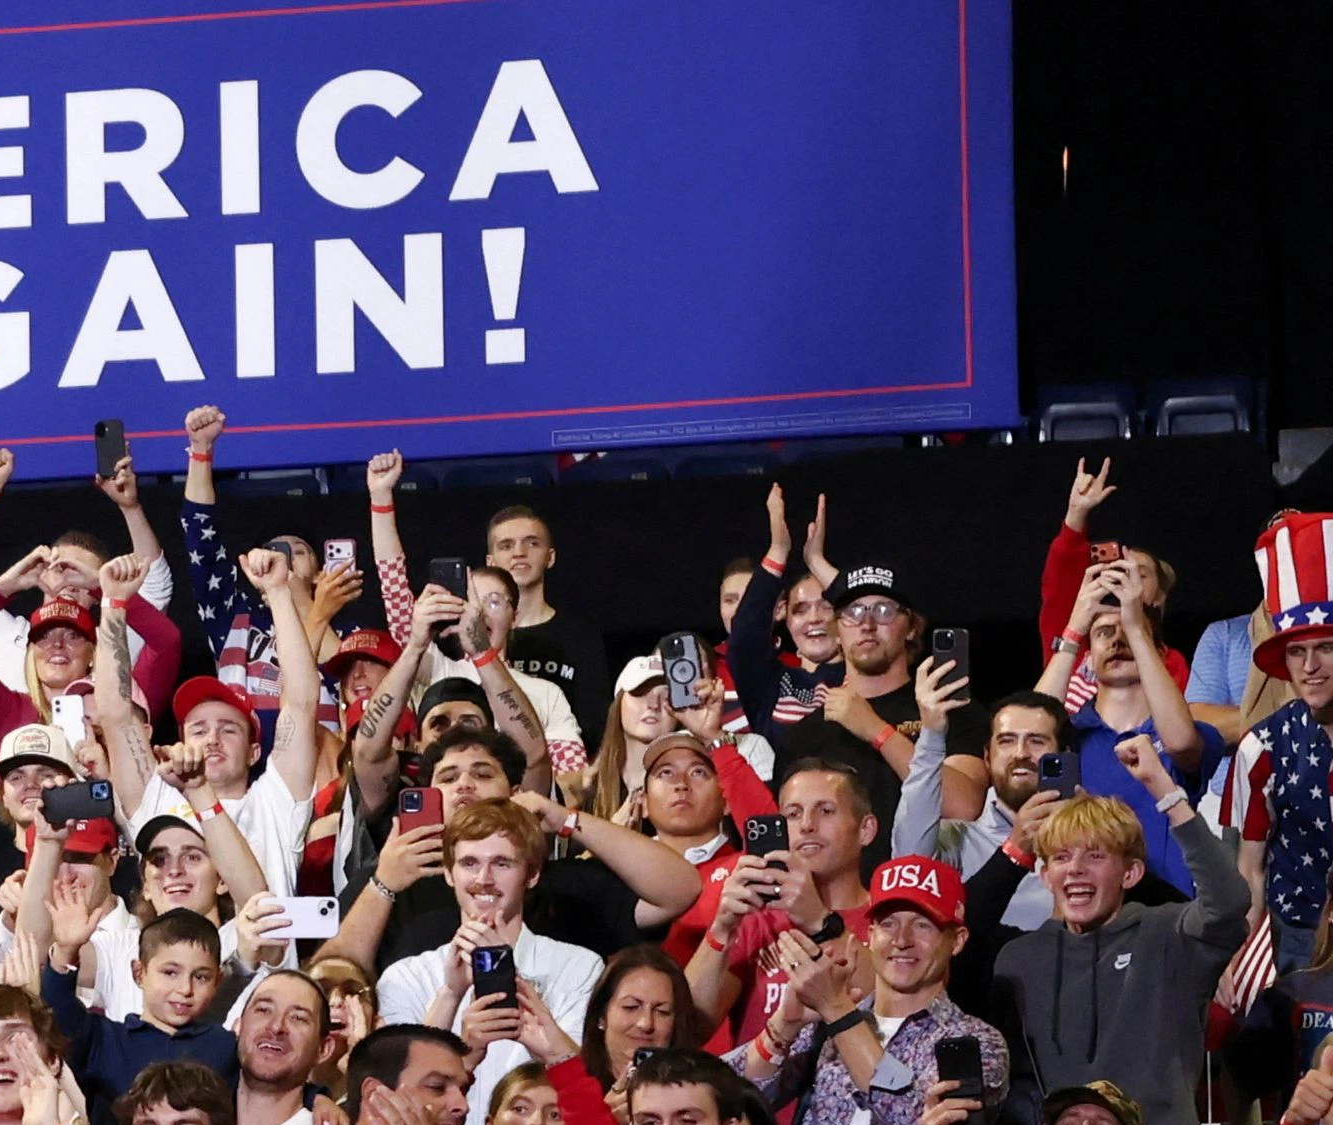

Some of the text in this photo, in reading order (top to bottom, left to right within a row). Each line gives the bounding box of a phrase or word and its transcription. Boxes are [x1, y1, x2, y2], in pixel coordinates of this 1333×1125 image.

[847, 566, 894, 580] LET'S GO
[514, 660, 575, 680] EDOM
[881, 865, 942, 898] USA
